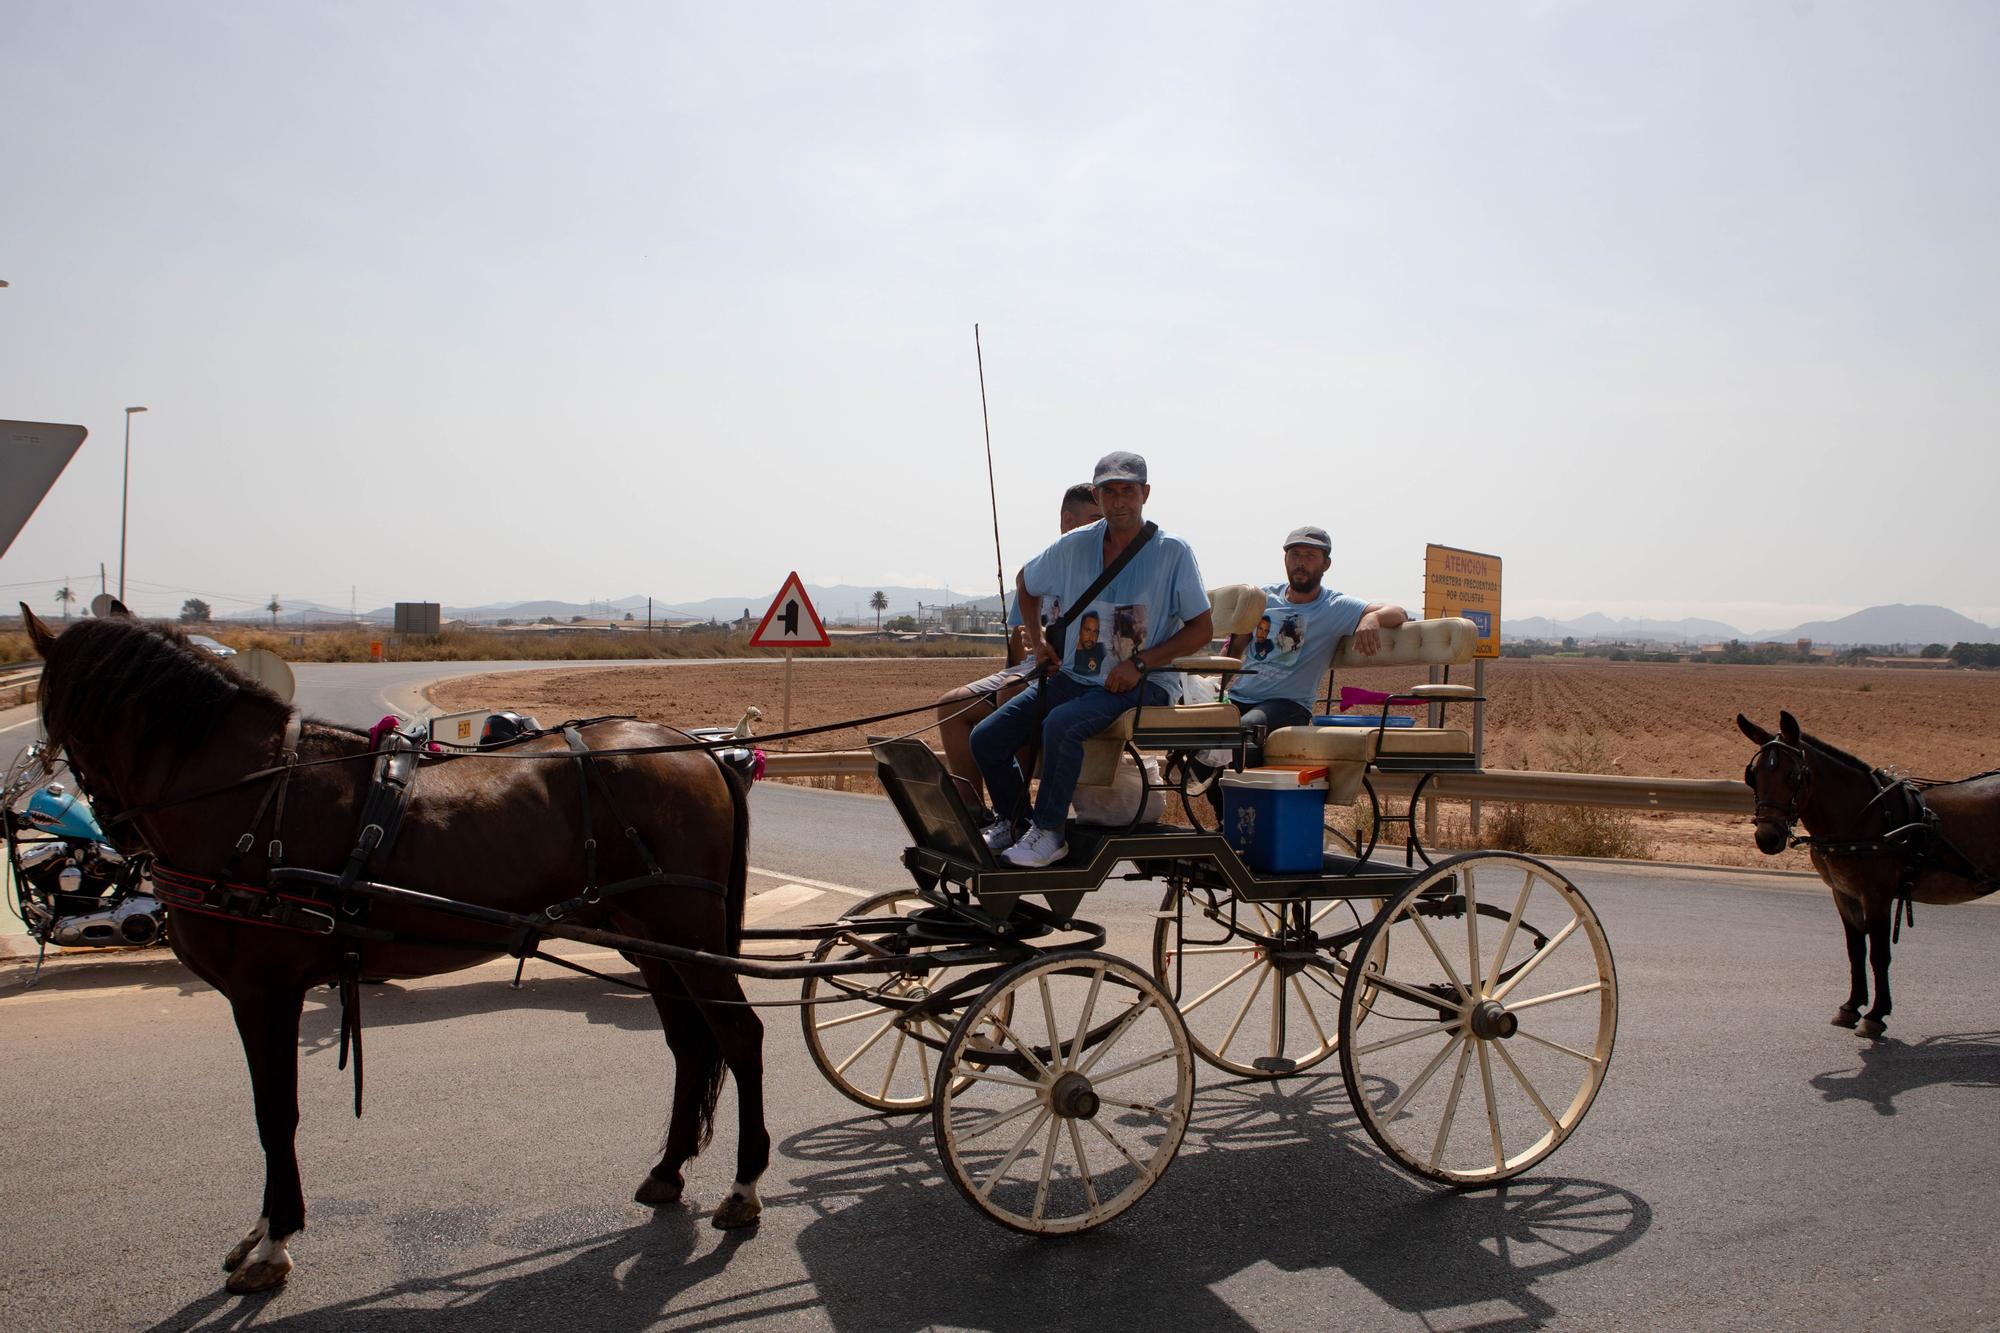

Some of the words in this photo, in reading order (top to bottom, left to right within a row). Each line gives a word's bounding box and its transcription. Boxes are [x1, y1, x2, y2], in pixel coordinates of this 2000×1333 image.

[1431, 573, 1461, 587] CARRETERA
[1463, 578, 1497, 592] FRECUENTADA
[1446, 590, 1457, 601] POR
[1459, 591, 1485, 604] CICLISTAS
